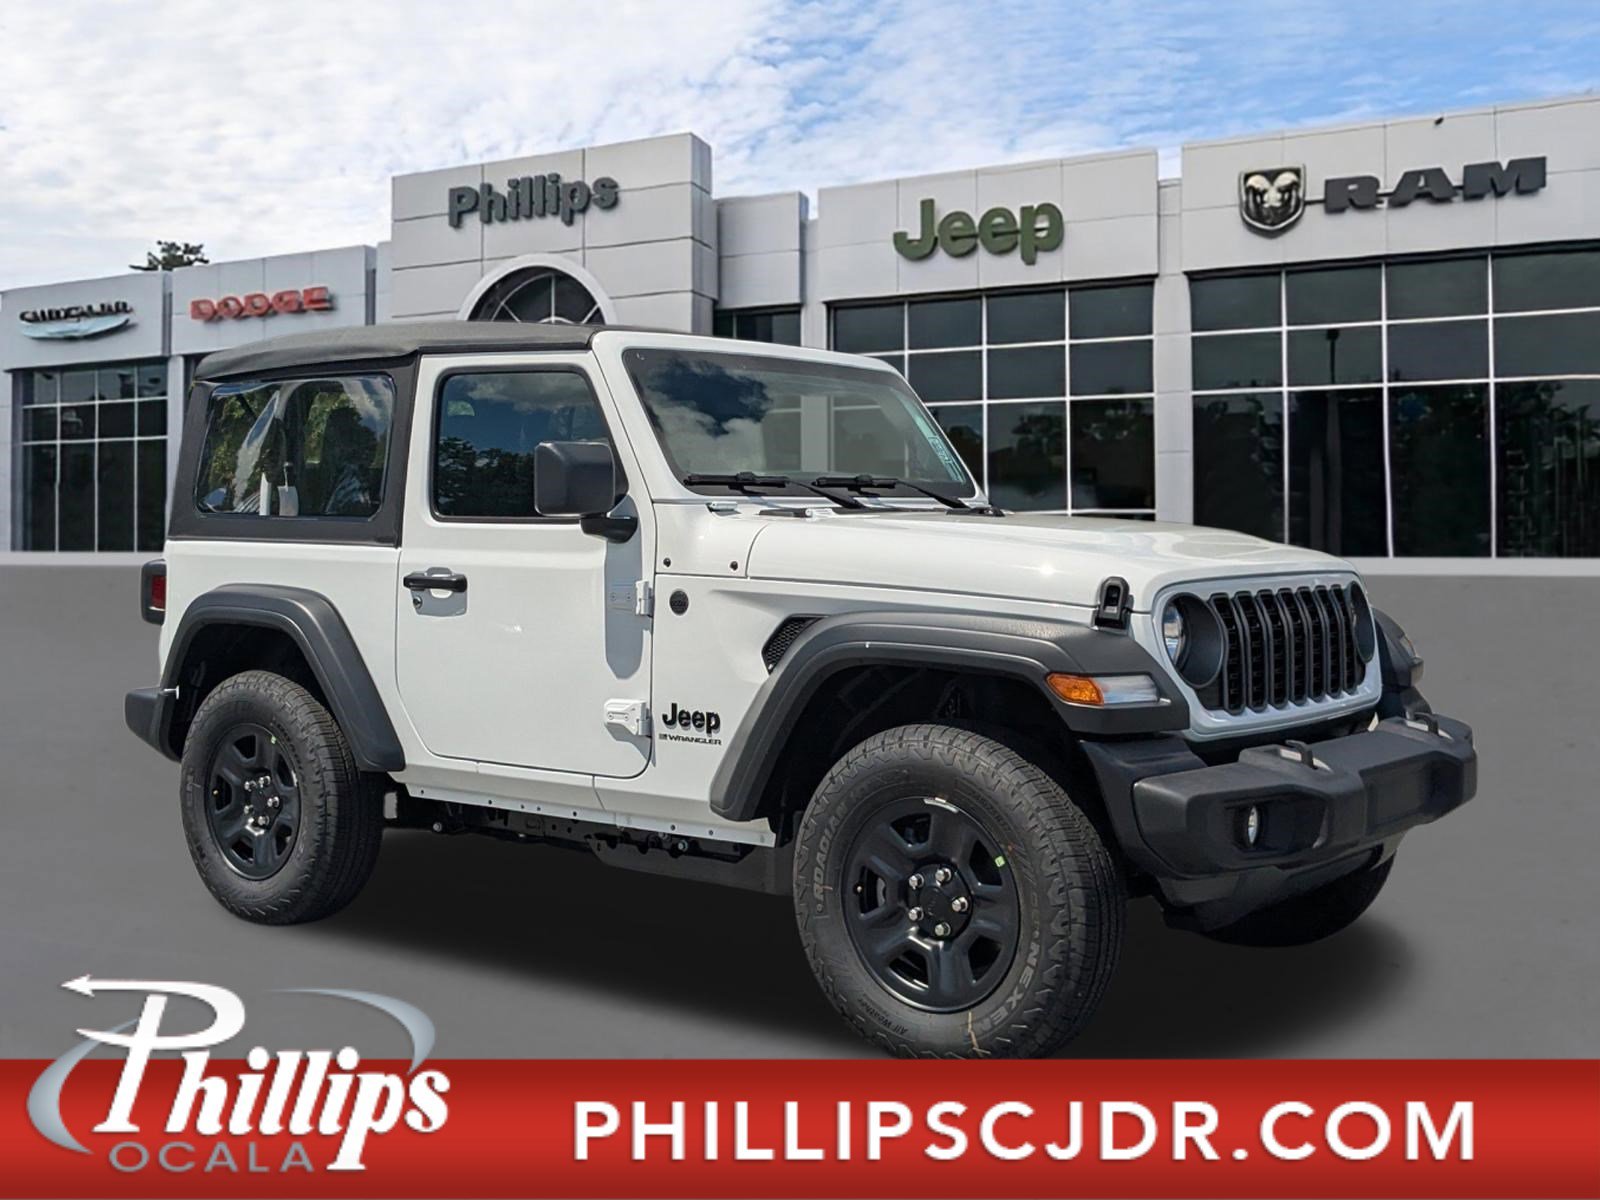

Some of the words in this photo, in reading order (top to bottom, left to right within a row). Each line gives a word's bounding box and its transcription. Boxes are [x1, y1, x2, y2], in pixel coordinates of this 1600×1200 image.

[448, 173, 619, 229] Phillips
[1324, 156, 1547, 214] RAM
[893, 198, 1064, 266] Jeep
[190, 286, 334, 322] DODGE
[662, 702, 721, 735] Jeep
[668, 733, 722, 746] WRANGLER
